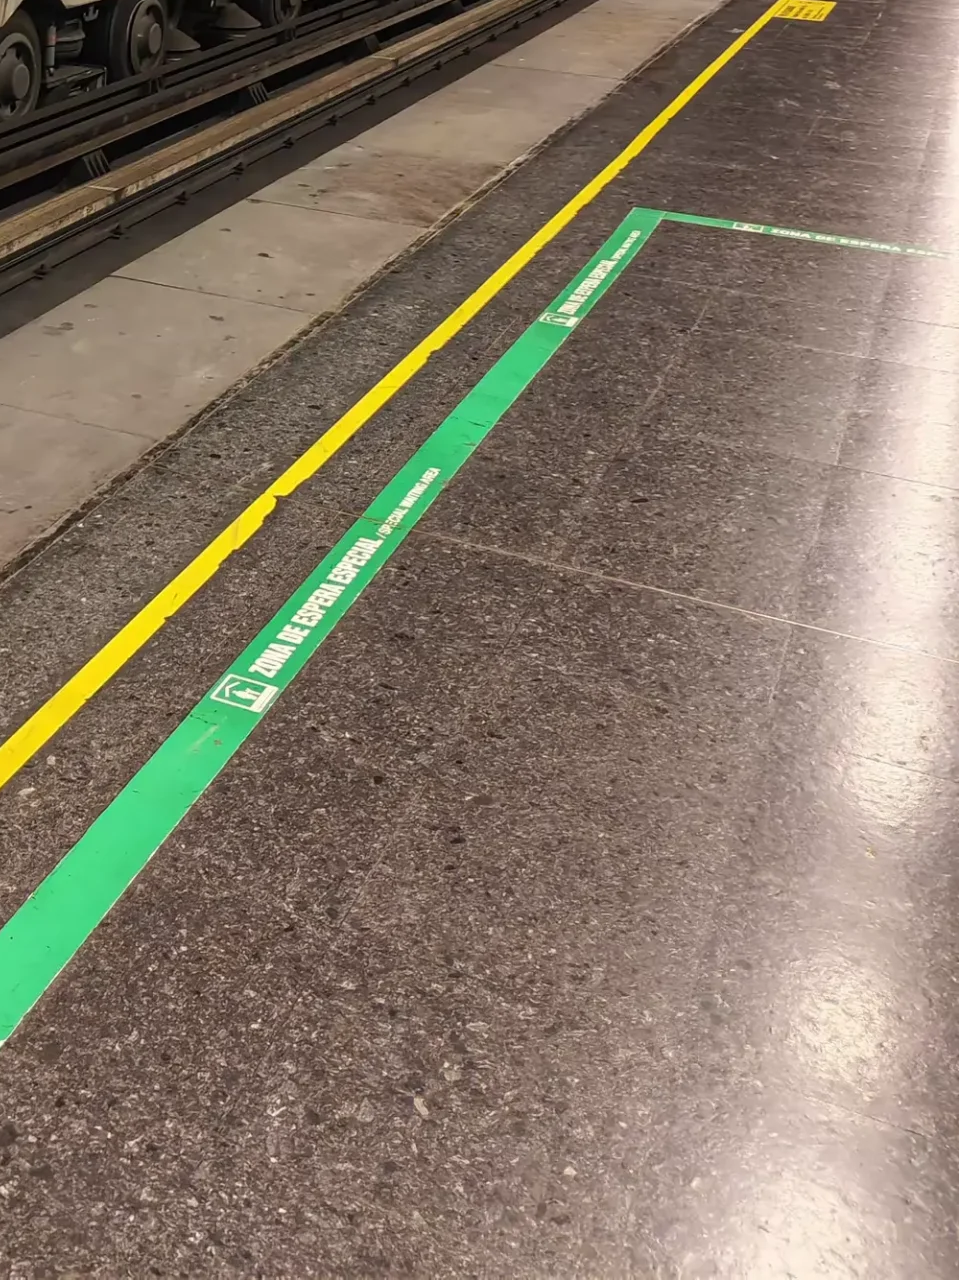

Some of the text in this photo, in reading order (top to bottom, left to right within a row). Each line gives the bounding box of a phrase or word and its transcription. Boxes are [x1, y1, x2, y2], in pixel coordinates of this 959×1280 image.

[378, 508, 409, 535] SPECIAL
[326, 537, 384, 584] ESPECIAL
[291, 583, 346, 627] ESPERA
[276, 624, 311, 645] DE
[248, 642, 297, 679] ZONA
